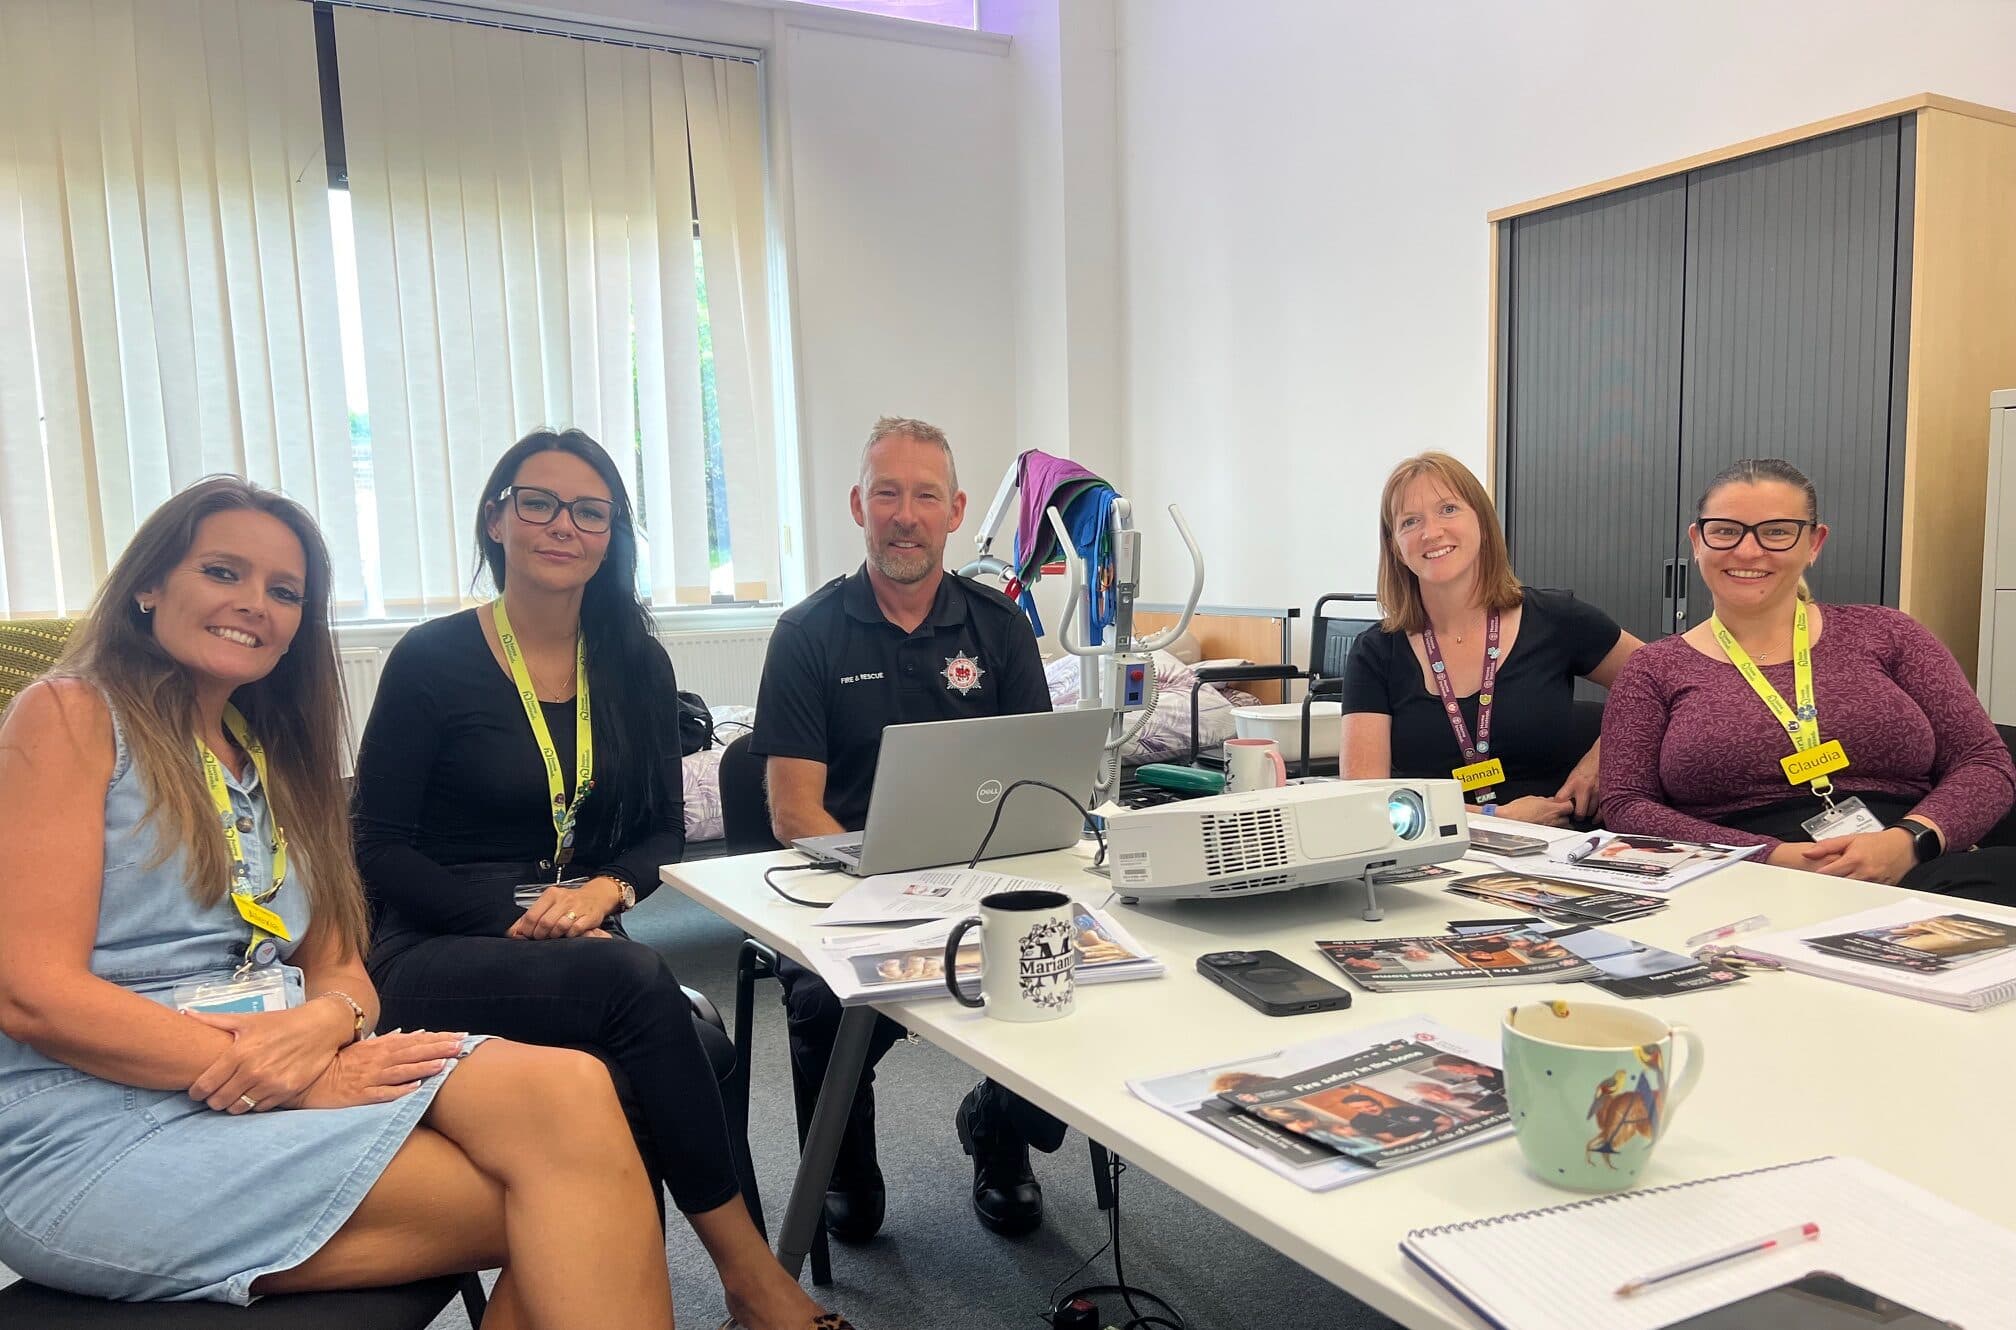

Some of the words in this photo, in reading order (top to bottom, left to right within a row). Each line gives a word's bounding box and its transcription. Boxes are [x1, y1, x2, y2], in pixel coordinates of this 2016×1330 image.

[840, 676, 854, 684] FIRE
[860, 672, 885, 680] RESCUE
[1788, 750, 1840, 775] Claudia
[1456, 766, 1499, 783] Hannah
[980, 788, 998, 796] DELL
[1293, 1081, 1322, 1092] Fire
[1321, 1070, 1360, 1083] safety
[1369, 1060, 1392, 1069] the
[1388, 1051, 1424, 1062] home
